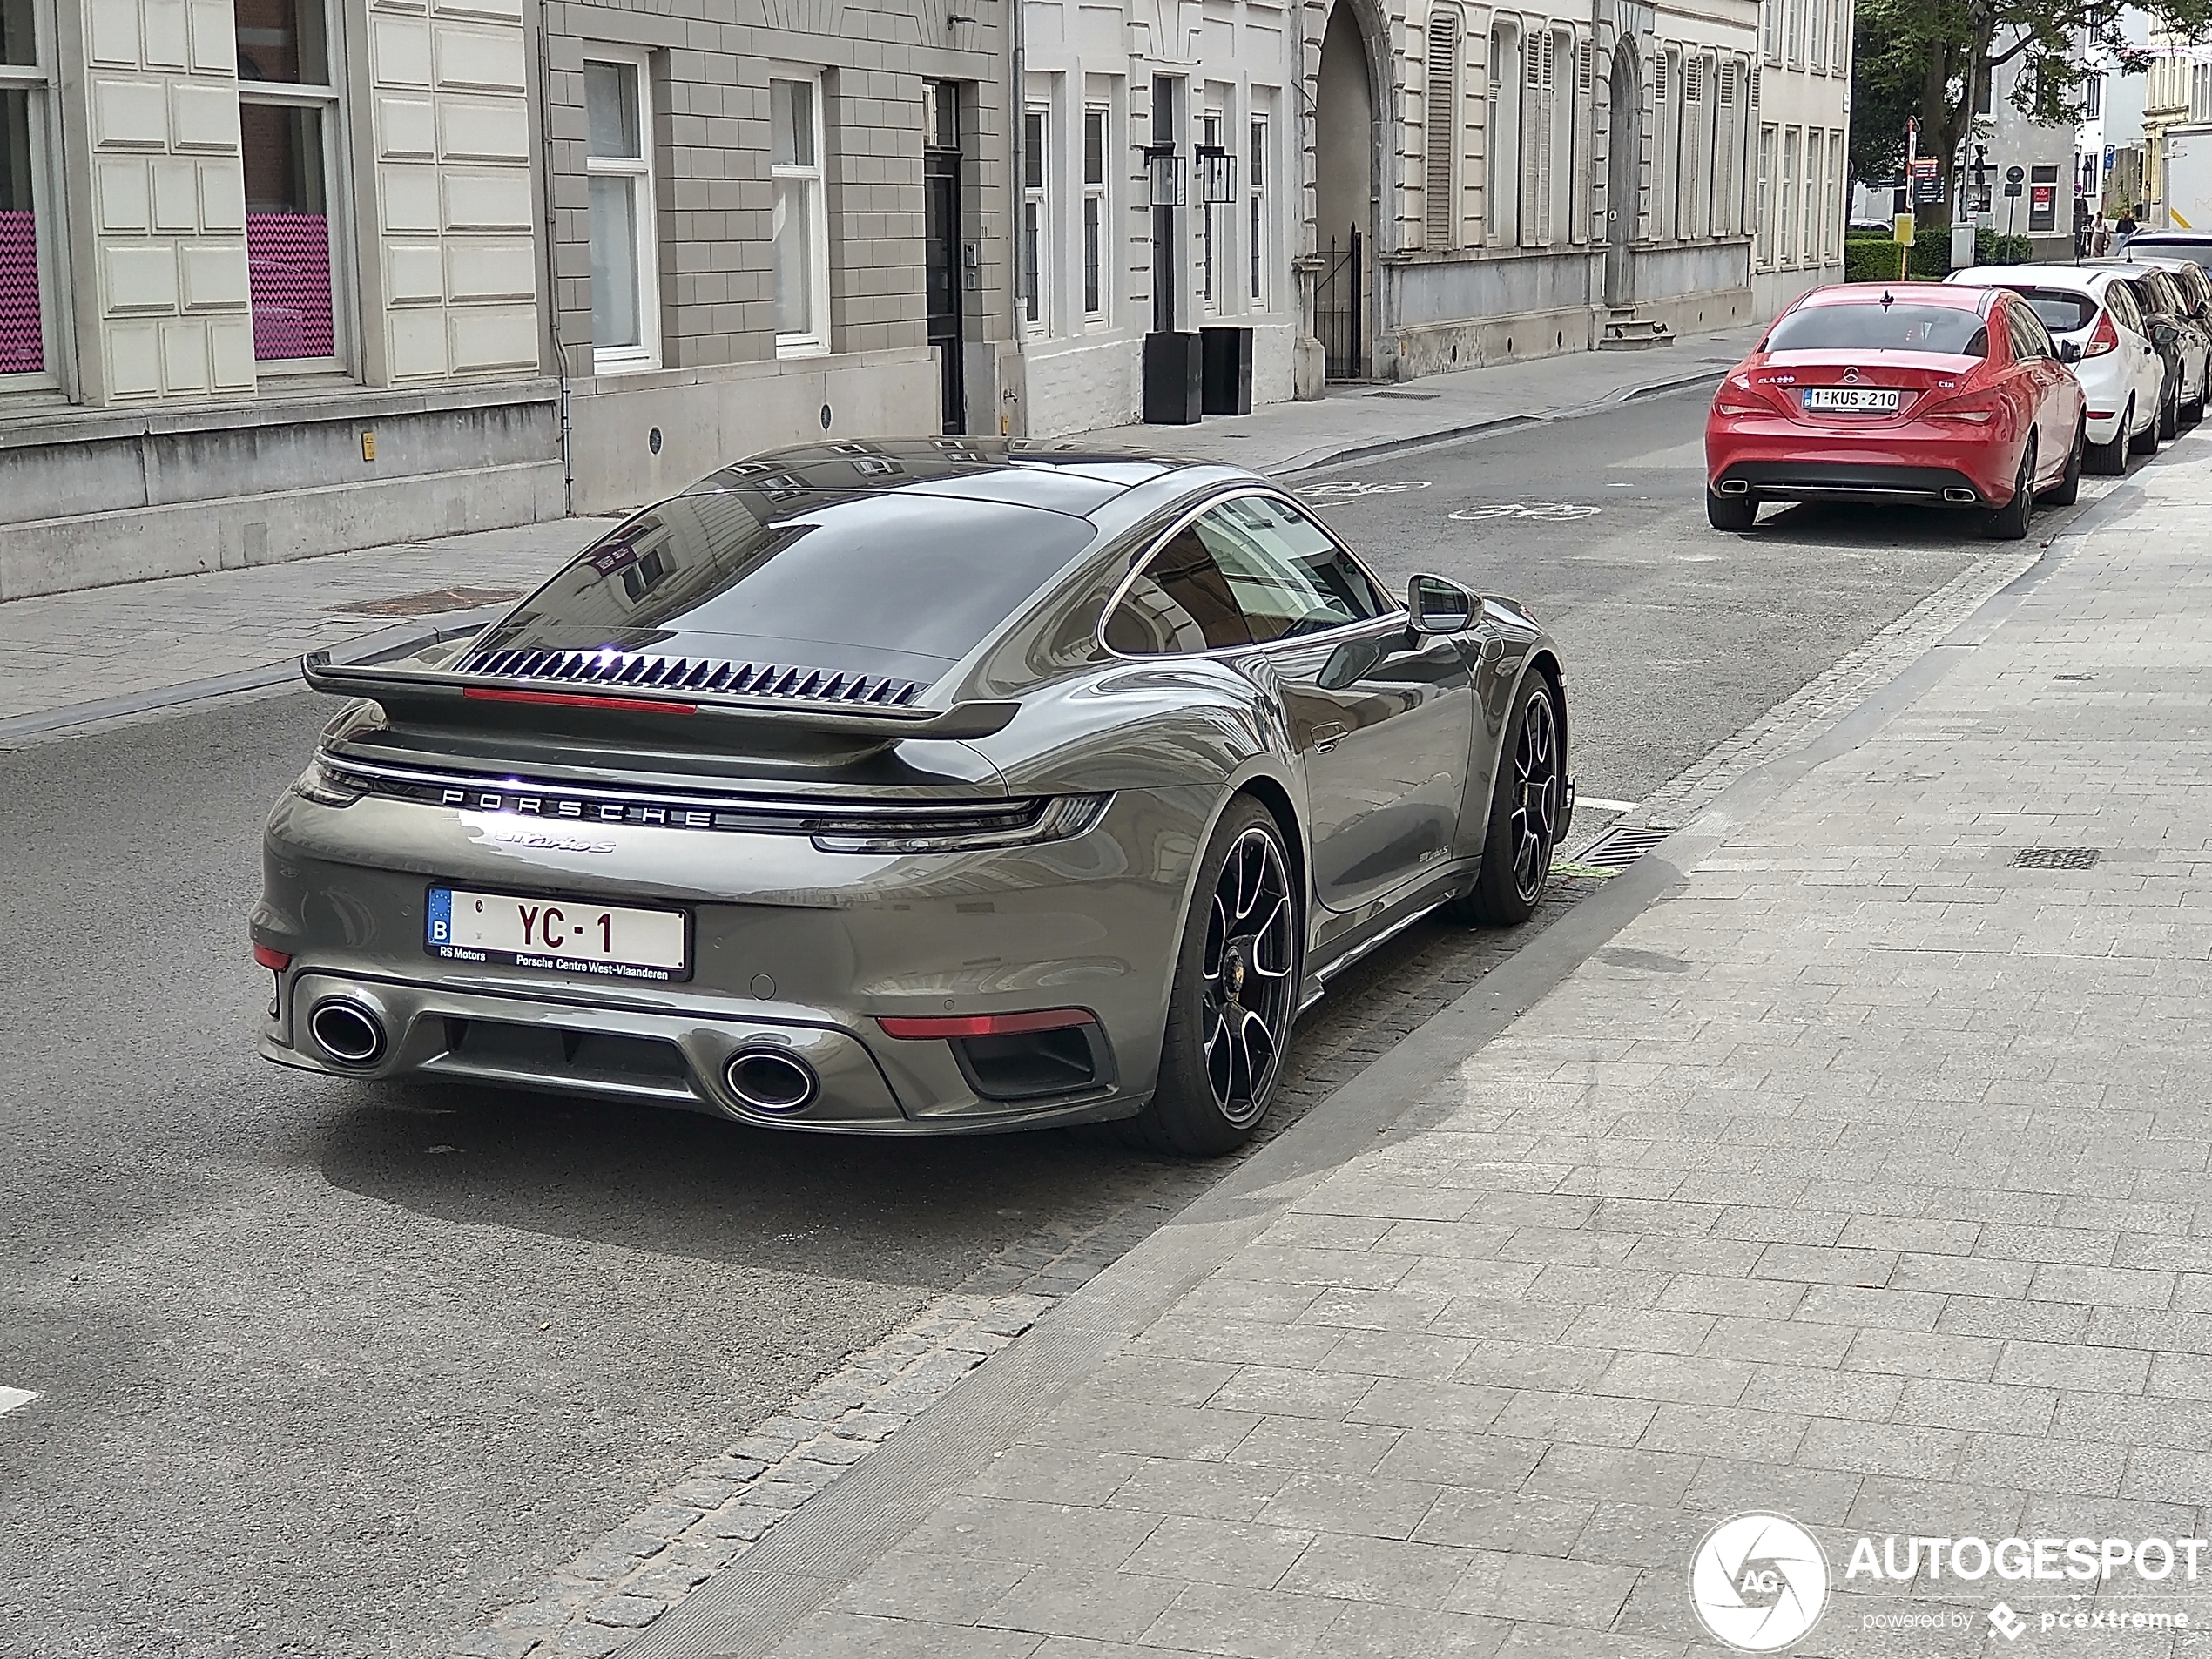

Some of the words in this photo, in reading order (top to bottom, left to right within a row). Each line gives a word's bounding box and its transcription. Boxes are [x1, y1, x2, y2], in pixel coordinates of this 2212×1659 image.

[442, 789, 711, 826] PORSCHE
[434, 921, 448, 940] B
[440, 946, 453, 957] RS
[454, 948, 486, 961] Motors
[516, 954, 553, 968] Porsche
[556, 959, 587, 972] Centre
[589, 961, 669, 981] West-Vlaanderen
